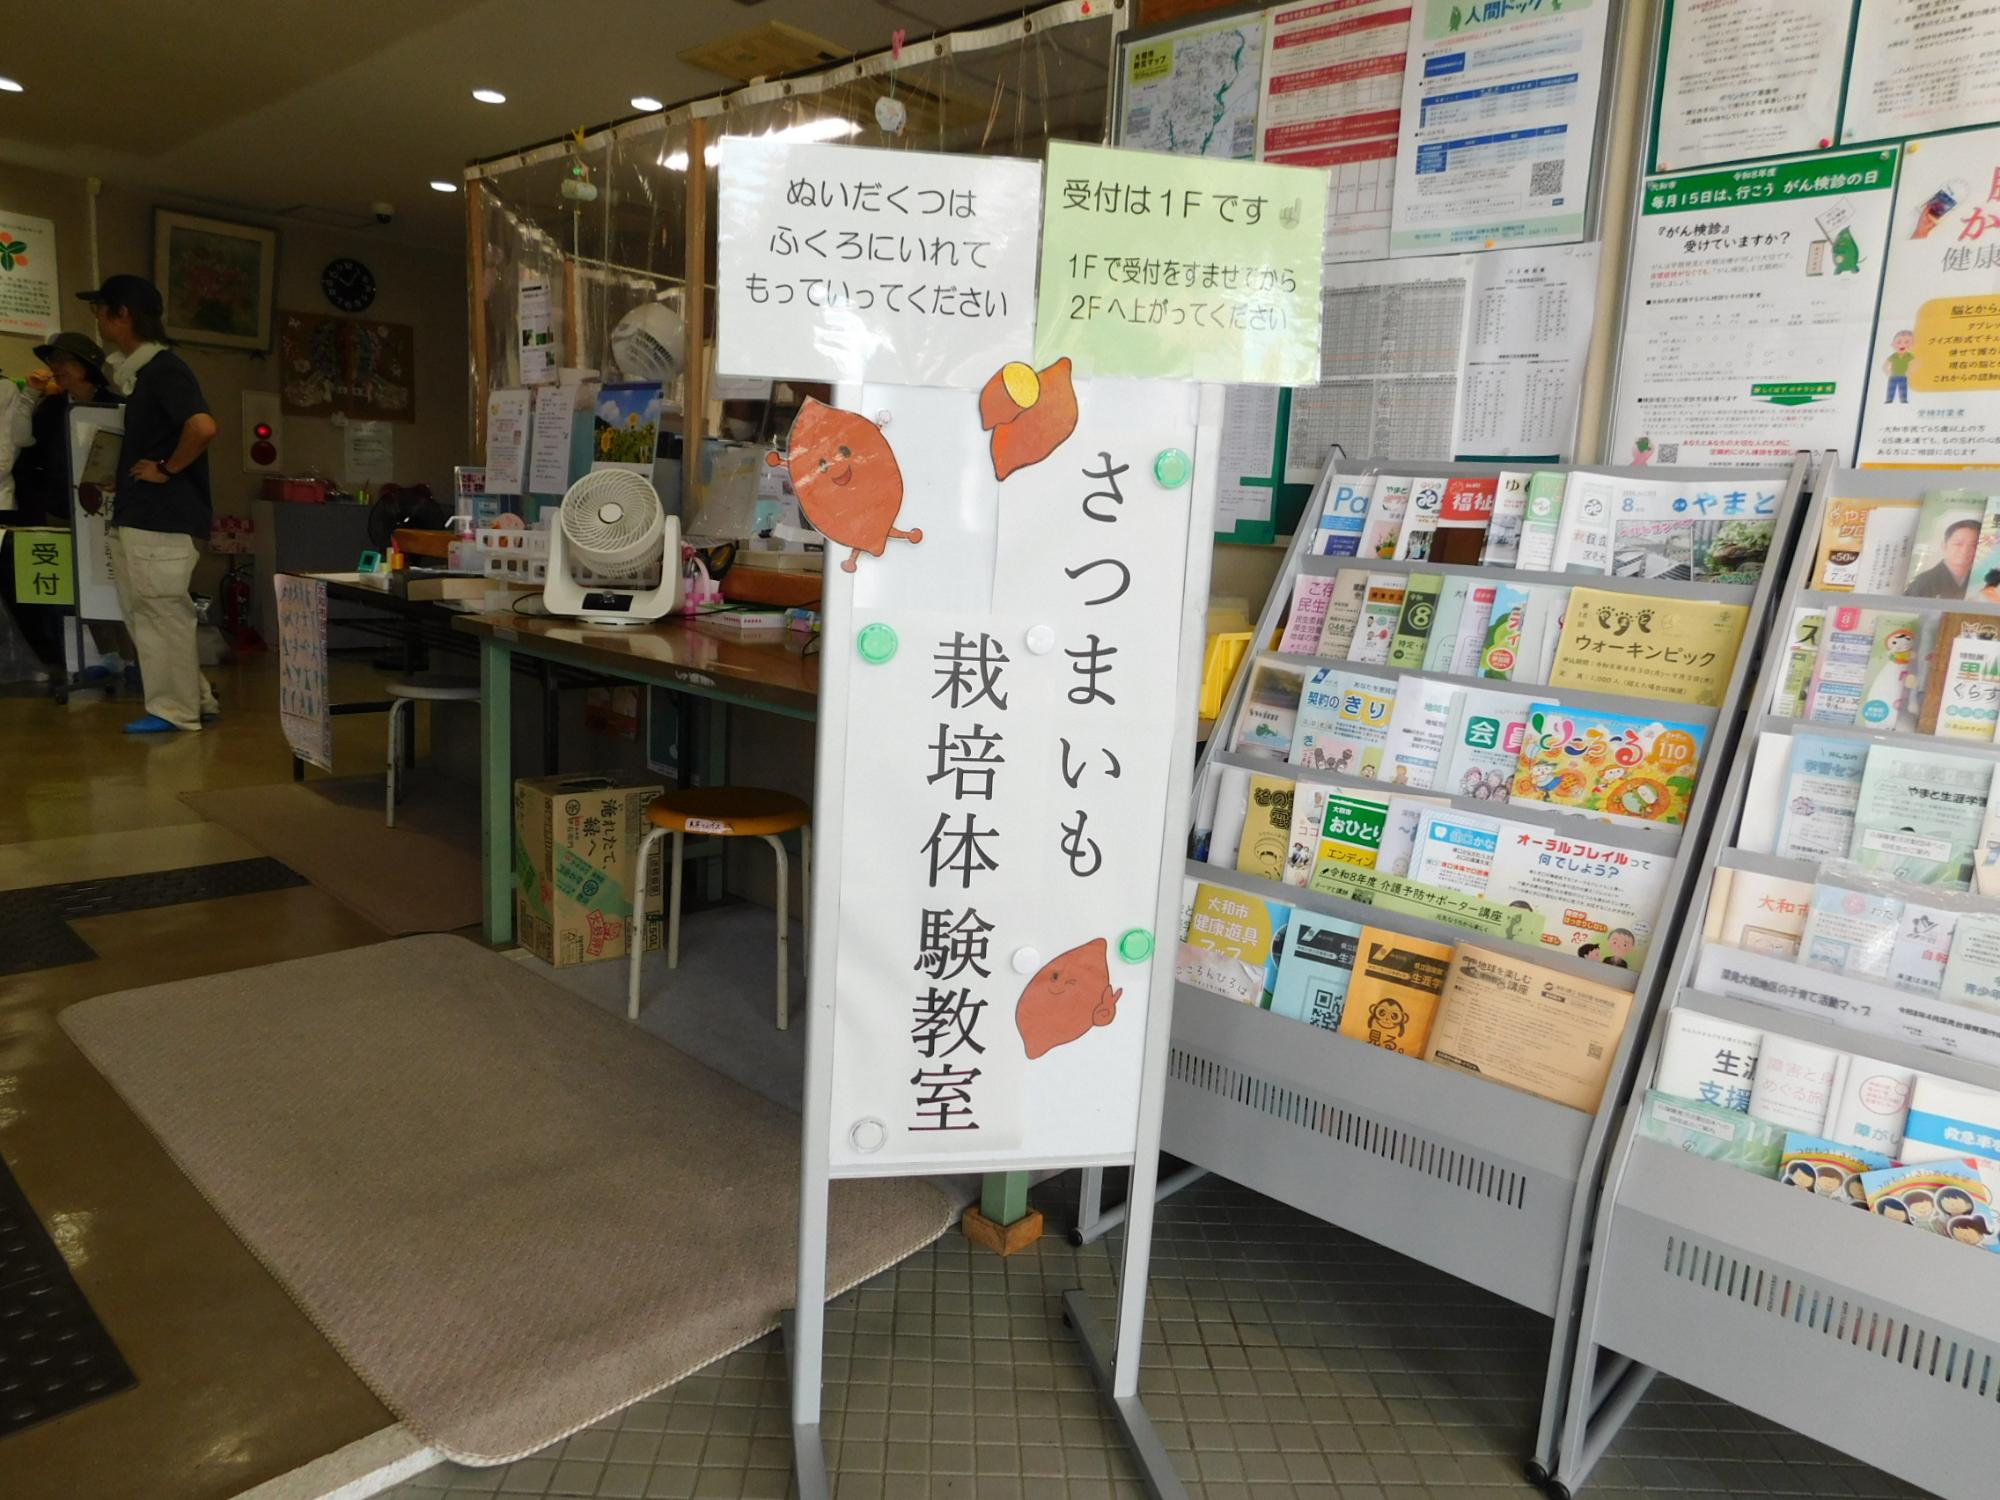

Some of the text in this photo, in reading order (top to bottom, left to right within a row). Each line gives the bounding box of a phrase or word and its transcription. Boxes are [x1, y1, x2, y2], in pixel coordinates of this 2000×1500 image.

[786, 177, 977, 218] ぬいだくつは
[1651, 169, 1879, 209] 毎月15日は、行こう がん検診の日
[769, 226, 991, 269] ふくろにいれて
[1657, 222, 1731, 239] 『がん検診』
[1683, 231, 1792, 254] 受けていますか？
[1068, 253, 1297, 293] 1Fで受付をすませてから
[745, 273, 1007, 317] もっていってください
[1069, 294, 1287, 331] 2Fへ上がってください
[1451, 491, 1494, 512] 福祉
[1692, 491, 1776, 515] やまと
[31, 542, 61, 596] 受付
[1059, 451, 1131, 877] さつまいも
[1575, 635, 1716, 668] ウォーキンピック
[1658, 742, 1688, 759] 110
[1516, 834, 1651, 871] オーラルフレイルって
[907, 630, 1011, 1132] 栽培体験教室
[1329, 867, 1378, 889] 令和8年度
[1380, 877, 1504, 922] 介護予防サポーター講座
[1207, 896, 1249, 919] 大和市
[1192, 914, 1259, 947] 健康遊具
